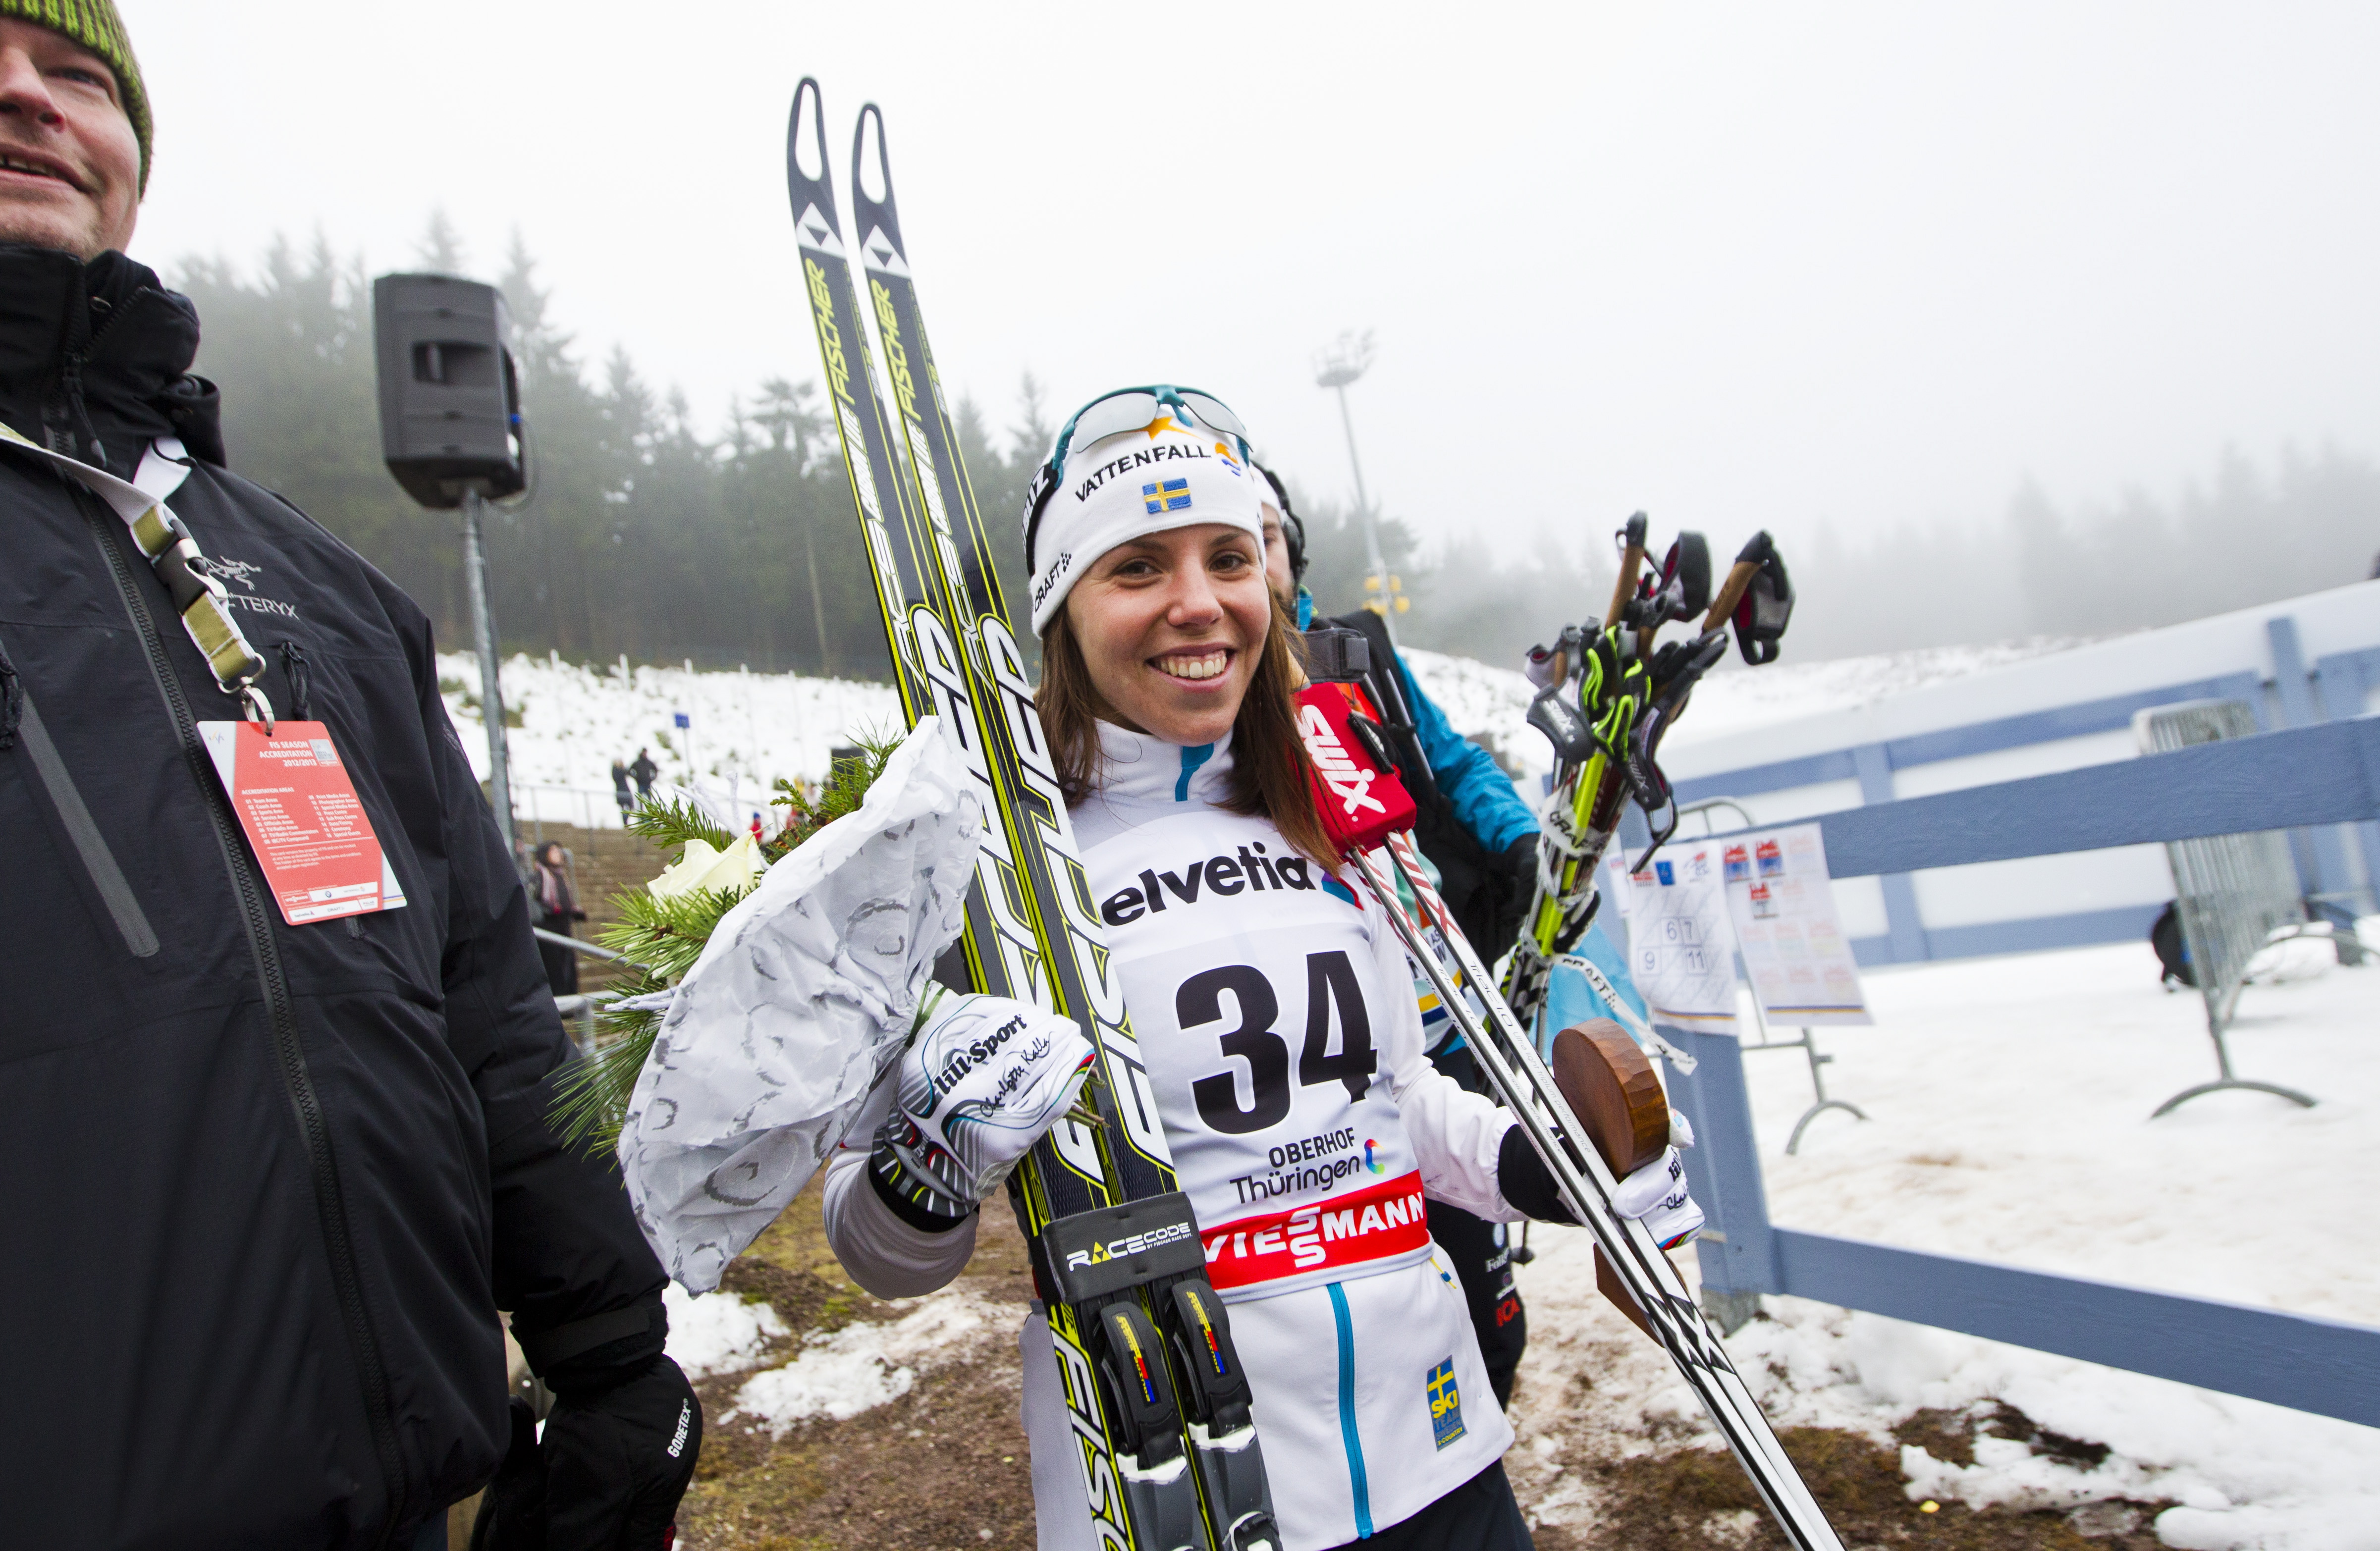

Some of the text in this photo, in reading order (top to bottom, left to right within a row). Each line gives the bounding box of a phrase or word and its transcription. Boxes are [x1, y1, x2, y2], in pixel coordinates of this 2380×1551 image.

[805, 258, 855, 405] FISCHER
[871, 279, 922, 422] FISCHER
[1075, 444, 1212, 502] VATTENFALL
[1034, 561, 1061, 613] CRAFT
[259, 750, 313, 758] ACCREDITATION
[980, 616, 1173, 1166] FISCHER
[1101, 841, 1316, 926] elvetia
[1644, 952, 1655, 970] 9
[1176, 951, 1377, 1135] 34
[1523, 1050, 1541, 1071] light
[1553, 1097, 1593, 1155] performance
[1269, 1127, 1355, 1169] OBERHOF
[1230, 1155, 1360, 1204] Thüringen
[1153, 1238, 1171, 1247] FISCHER
[1431, 1390, 1459, 1419] SKI
[1434, 1409, 1460, 1431] TEAM
